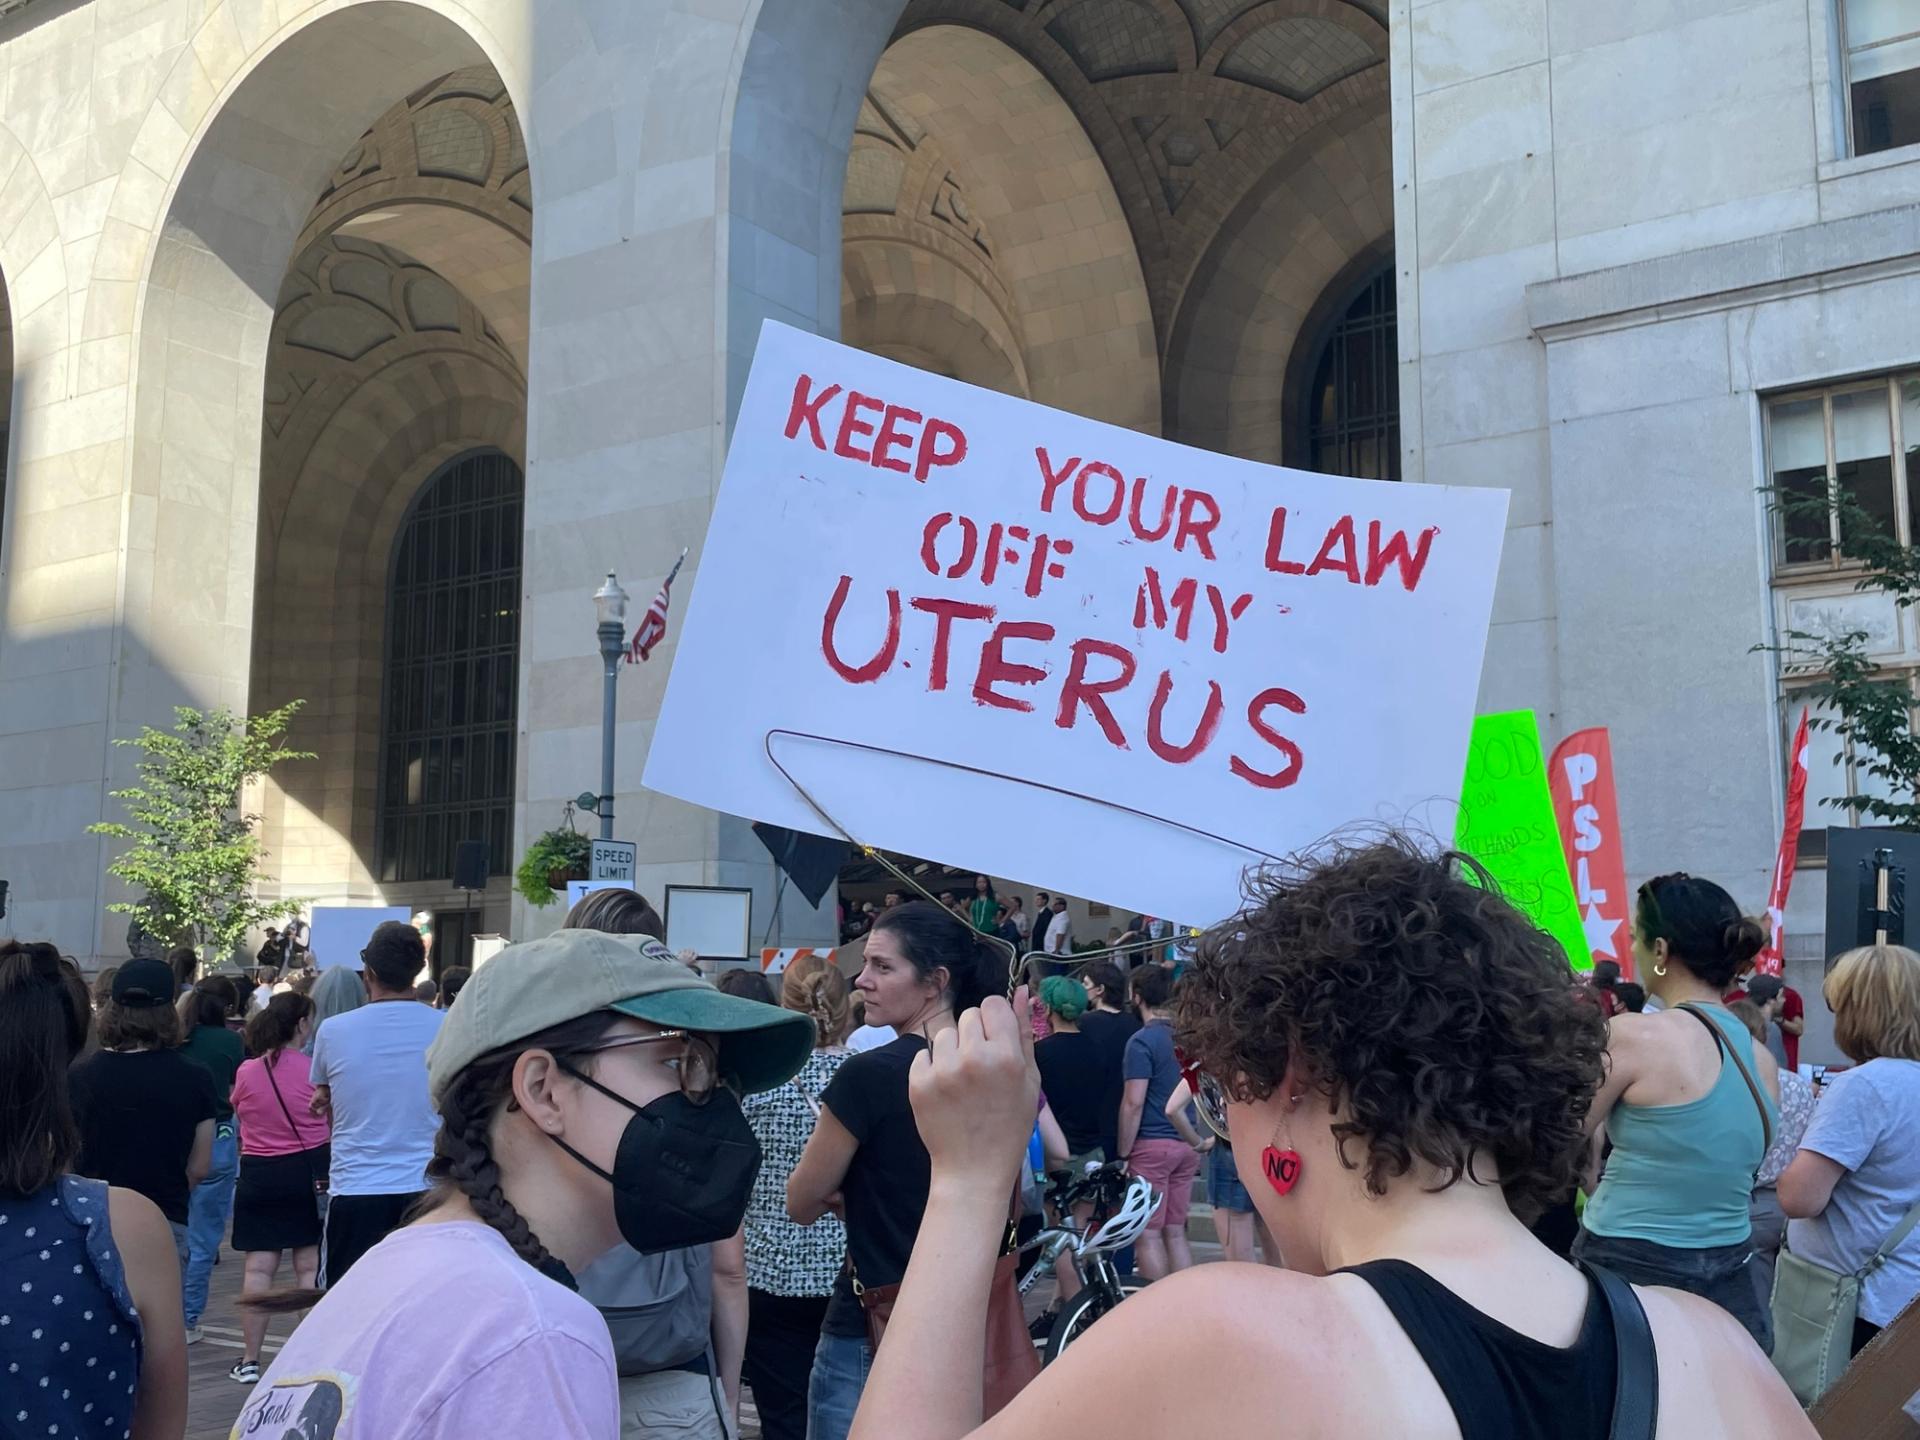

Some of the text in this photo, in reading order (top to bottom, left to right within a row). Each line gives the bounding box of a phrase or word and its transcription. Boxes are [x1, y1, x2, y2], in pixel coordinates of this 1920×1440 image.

[786, 375, 1436, 591] KEEP YOUR LAW
[921, 512, 1252, 652] OFF MY
[823, 576, 1305, 788] UTERUS
[595, 849, 633, 864] SPEED
[599, 867, 628, 880] LIMIT
[1563, 753, 1607, 905] PSL
[1266, 1152, 1297, 1183] NO
